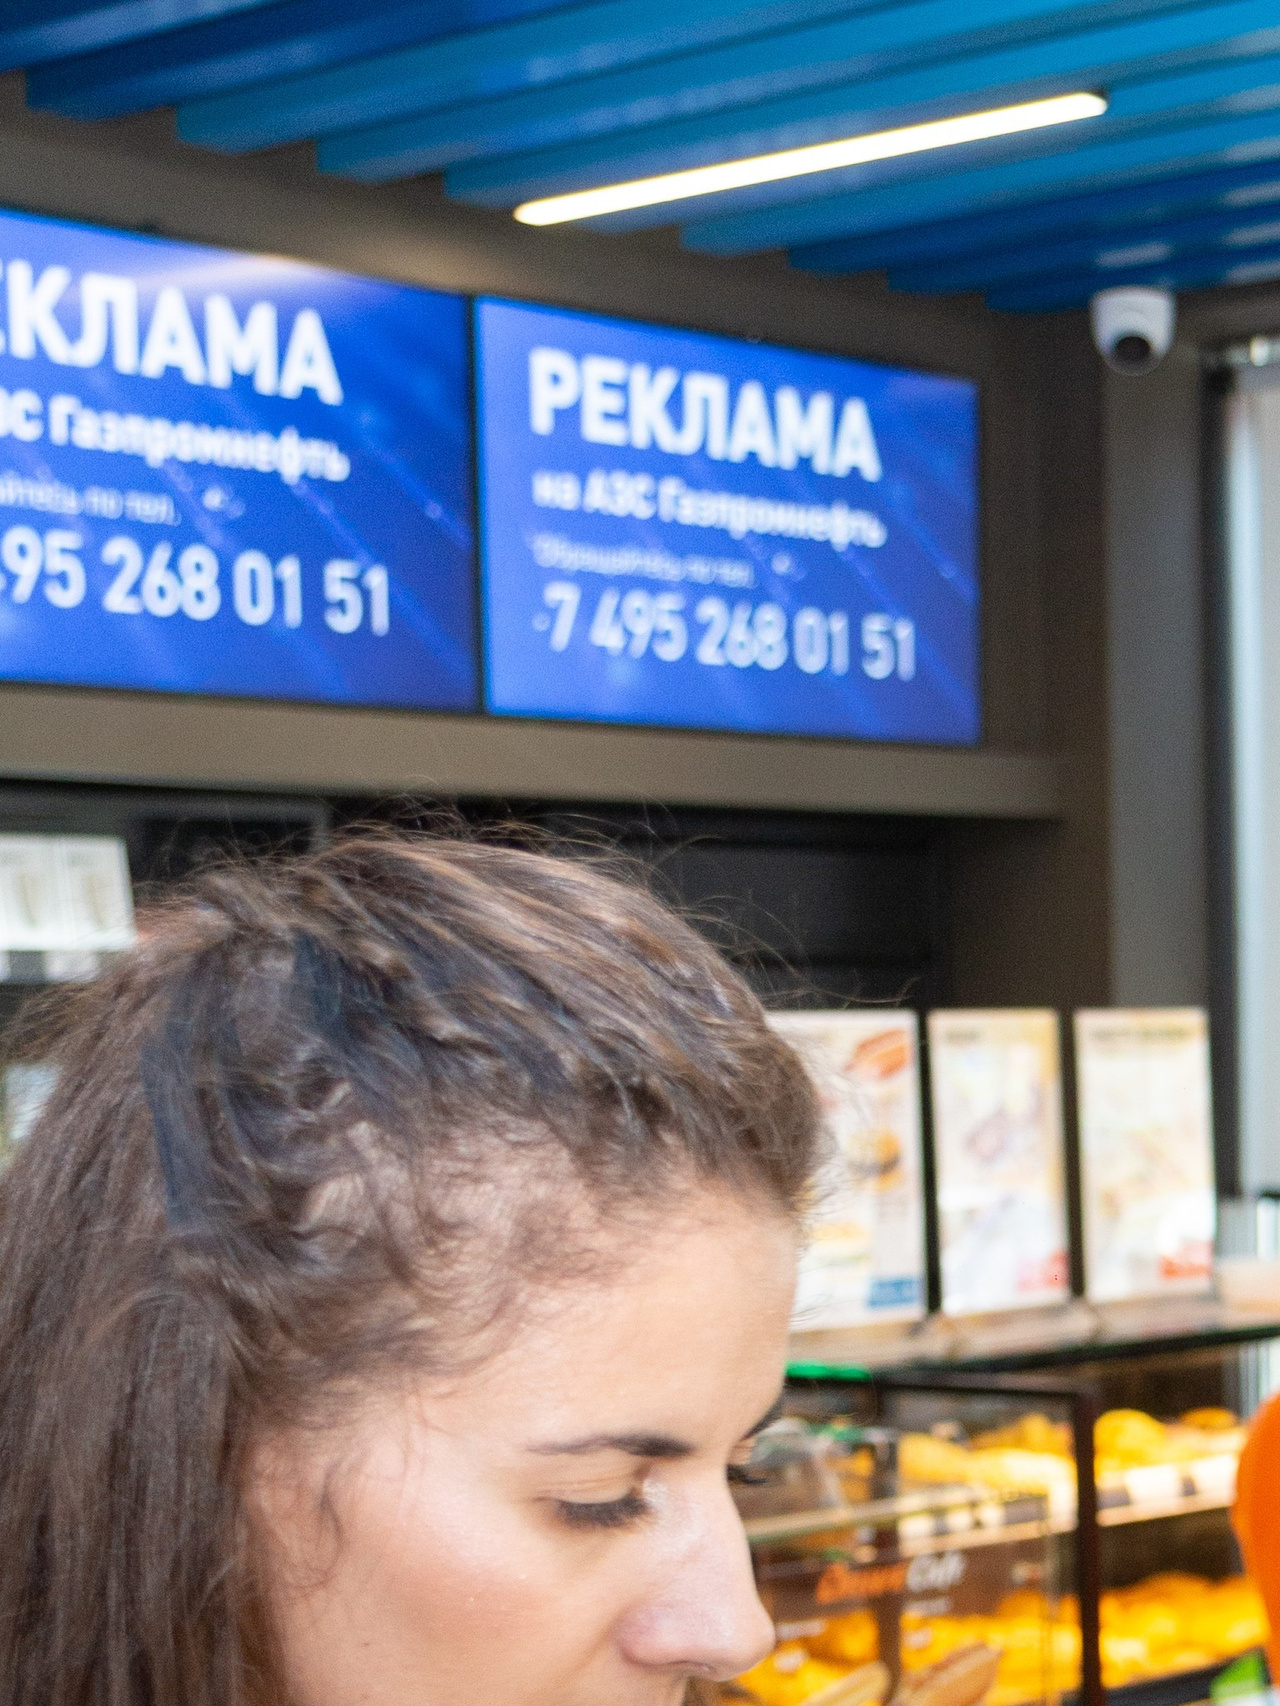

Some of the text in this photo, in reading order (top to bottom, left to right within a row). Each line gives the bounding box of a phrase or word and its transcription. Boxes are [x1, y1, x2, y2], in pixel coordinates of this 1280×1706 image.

[0, 258, 345, 406] КЛАМА
[50, 393, 351, 484] Газпромнефть
[528, 345, 883, 483] РЕКЛАМА
[531, 468, 887, 552] на АЗС Газпромнефть
[0, 525, 390, 638] 95 268 01 51
[589, 586, 688, 662] 495
[695, 595, 789, 671] 268
[793, 605, 851, 676] 01
[861, 611, 916, 682] 51
